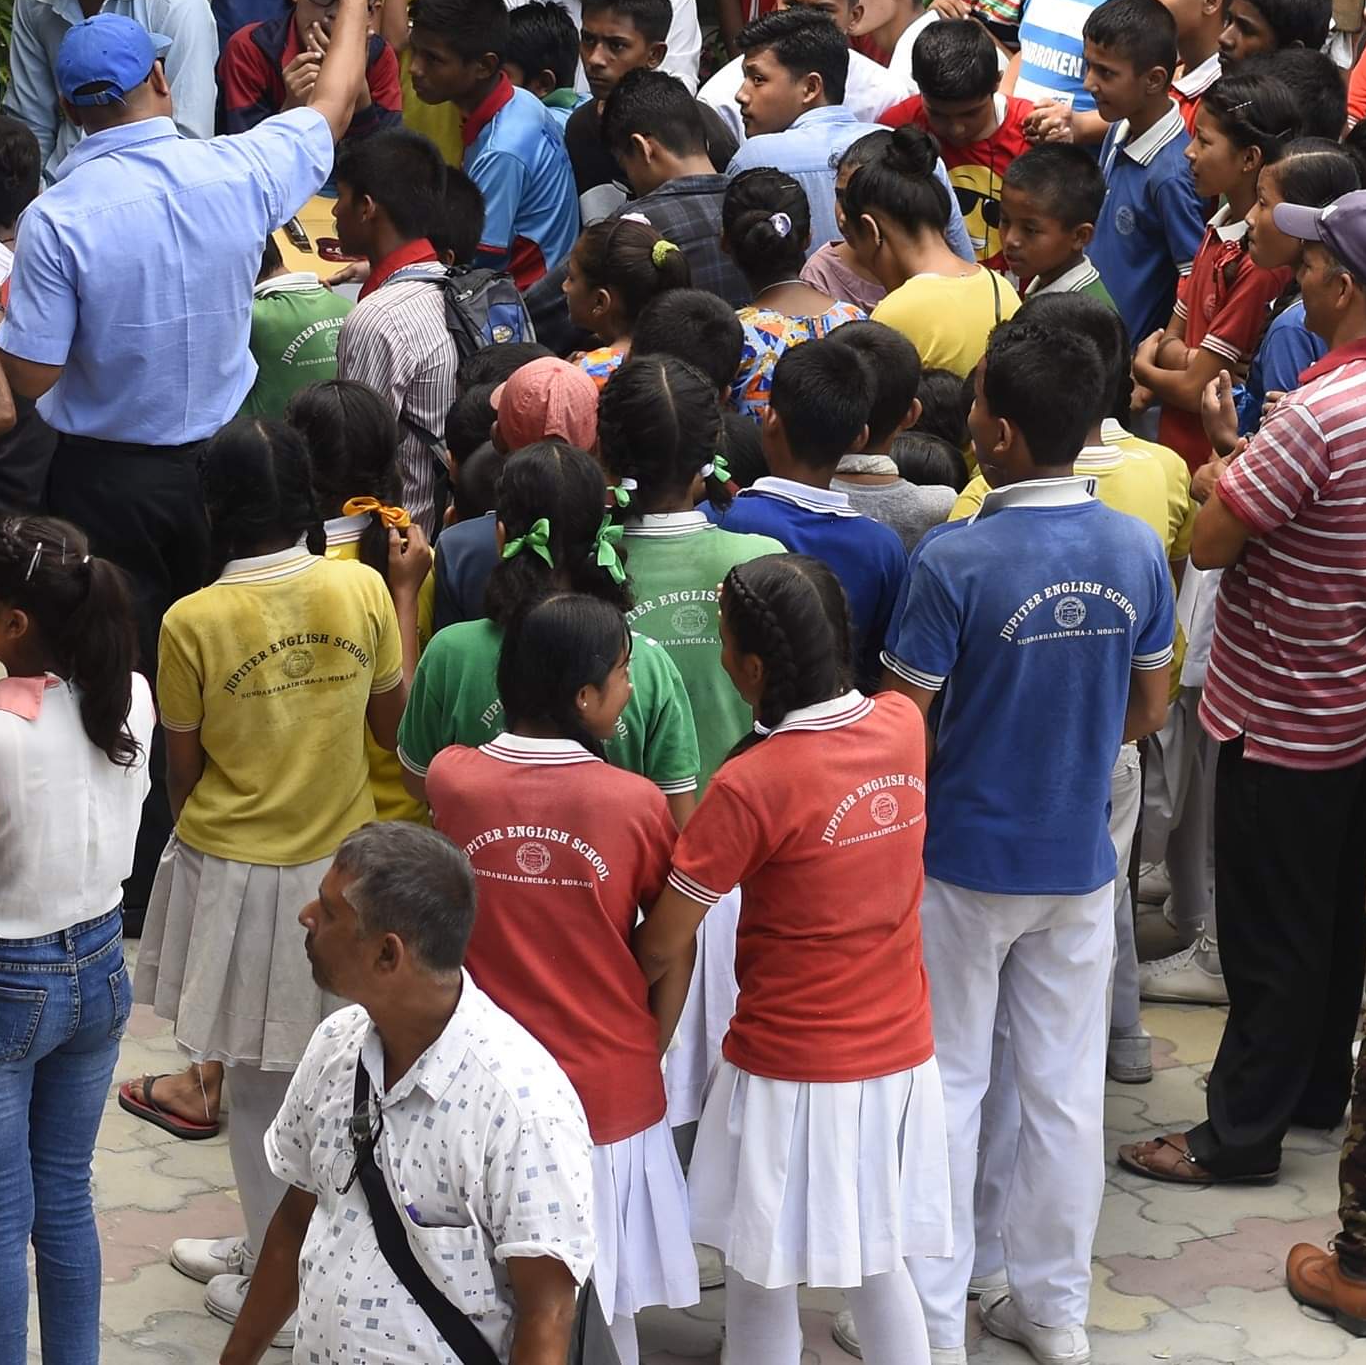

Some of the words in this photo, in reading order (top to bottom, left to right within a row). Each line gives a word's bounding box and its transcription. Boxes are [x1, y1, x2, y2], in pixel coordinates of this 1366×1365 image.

[281, 326, 315, 365] JUPITER
[314, 317, 345, 332] ENGLIS
[659, 590, 720, 606] ENGLIS
[999, 593, 1043, 642] JUPITER
[1044, 581, 1103, 599] ENGLISH
[223, 650, 268, 695] JUPITER
[270, 634, 330, 654] ENGLISH
[333, 637, 370, 668] SCHOOL
[821, 794, 857, 846] JUPITER
[856, 774, 905, 800] ENGLISH
[463, 828, 504, 860] UPITER
[507, 826, 570, 844] ENGLISH
[571, 838, 610, 882] SCHOOL
